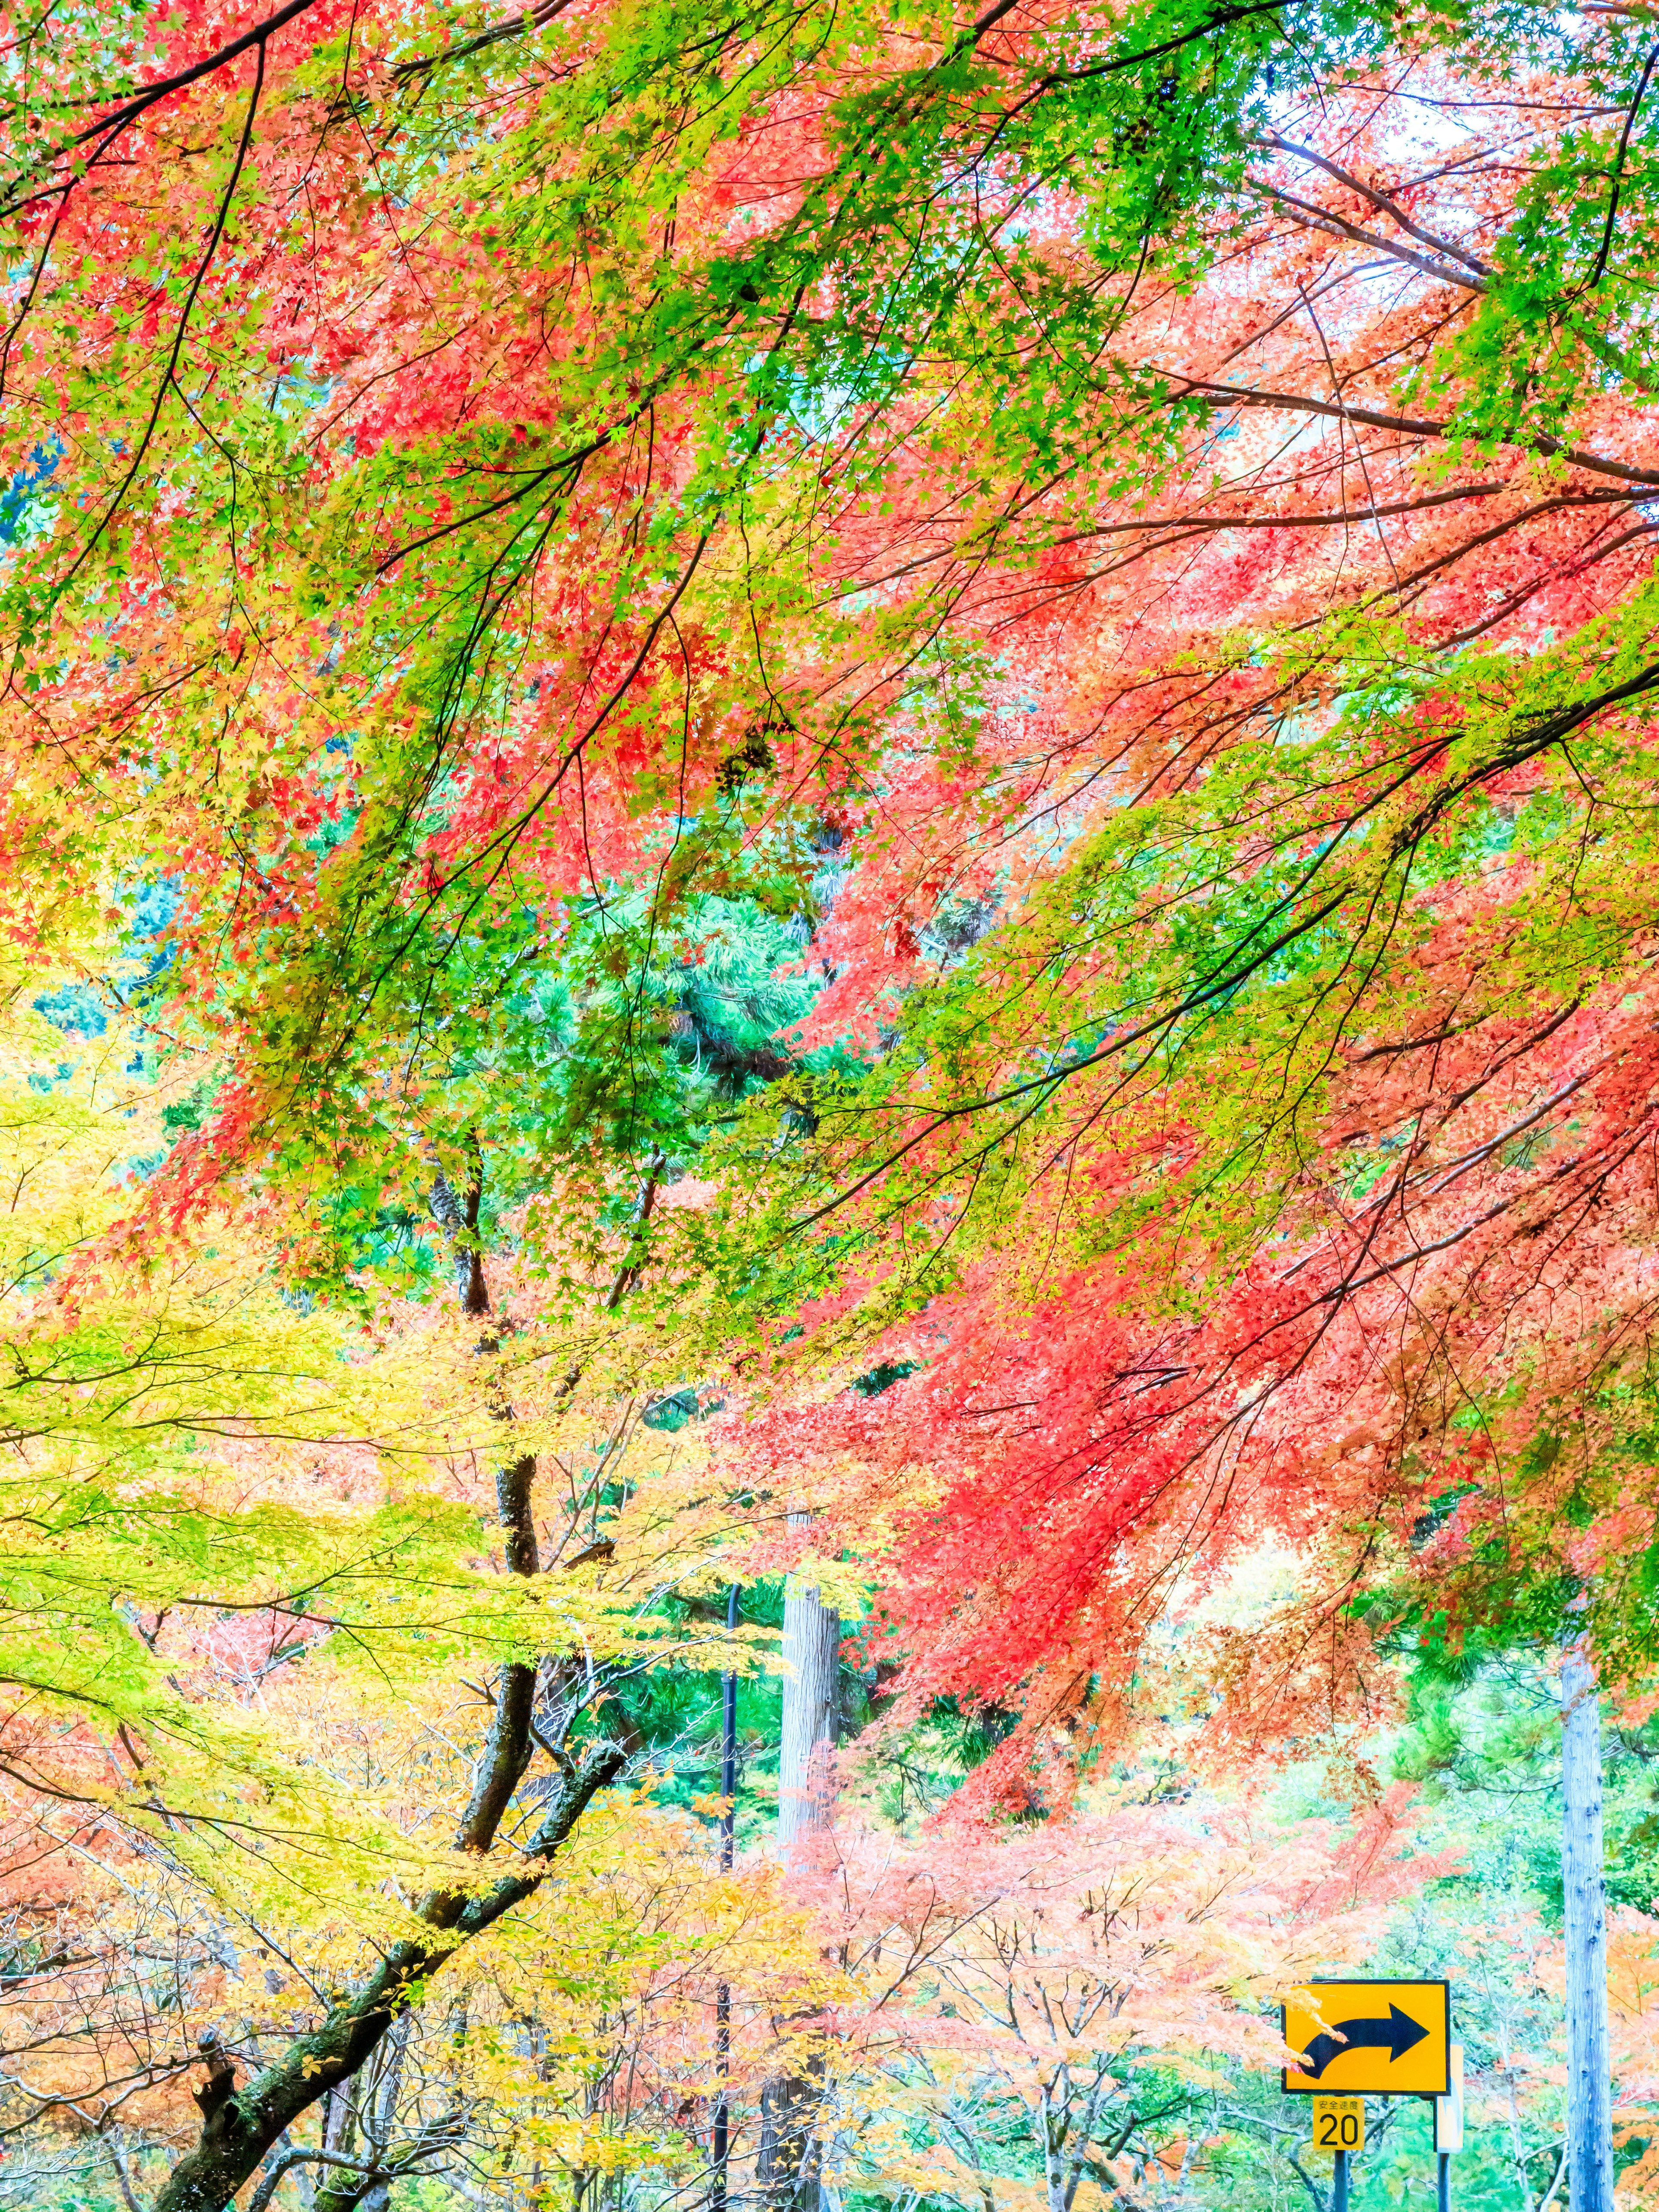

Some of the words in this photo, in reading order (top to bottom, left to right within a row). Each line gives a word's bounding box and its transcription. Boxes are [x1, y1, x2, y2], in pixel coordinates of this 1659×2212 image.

[1319, 2101, 1357, 2110] 安全速度
[1320, 2113, 1358, 2145] 20
